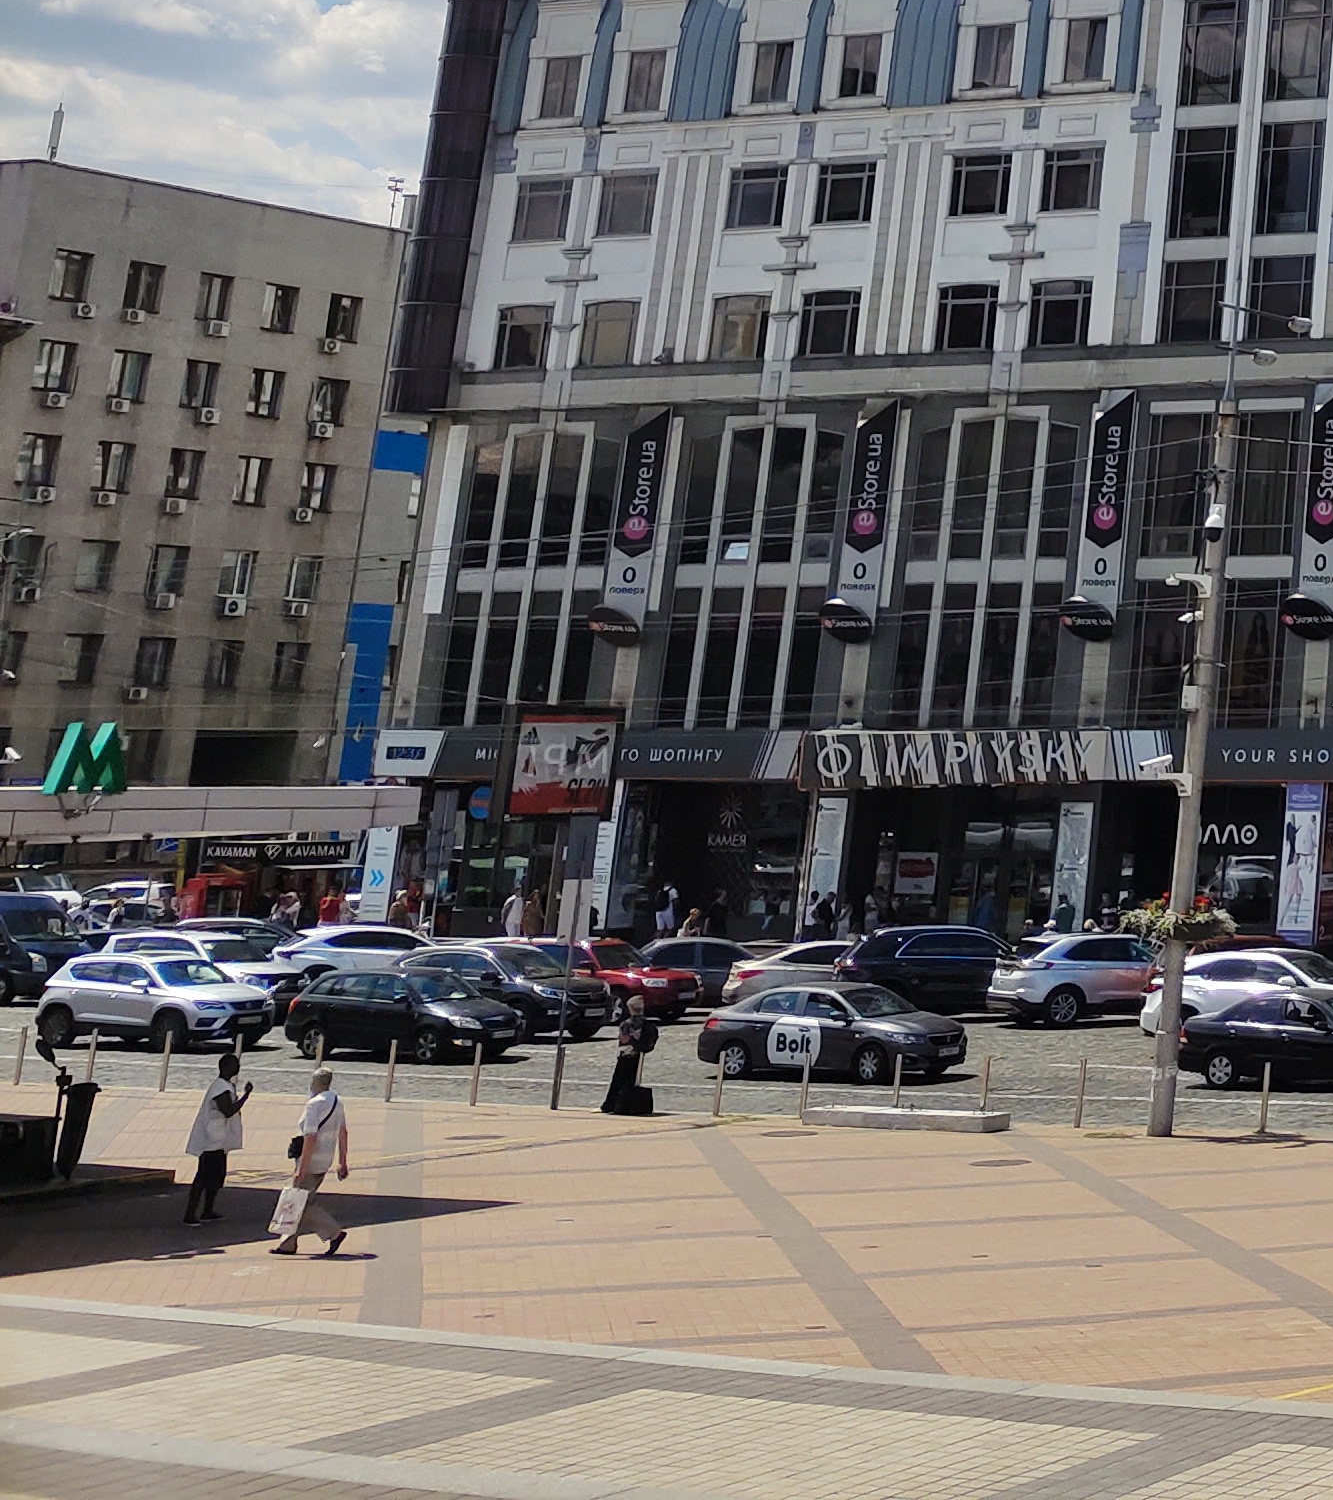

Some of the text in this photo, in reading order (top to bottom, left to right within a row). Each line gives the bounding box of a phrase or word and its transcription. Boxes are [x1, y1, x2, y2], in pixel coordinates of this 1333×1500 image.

[650, 749, 723, 762] ШОПІНГУ
[1221, 748, 1276, 763] YOUR
[707, 834, 747, 847] КАМЕЯ
[206, 846, 257, 858] KAVAMAN
[285, 845, 346, 857] KAVAMAN
[775, 1032, 812, 1054] Bolt
